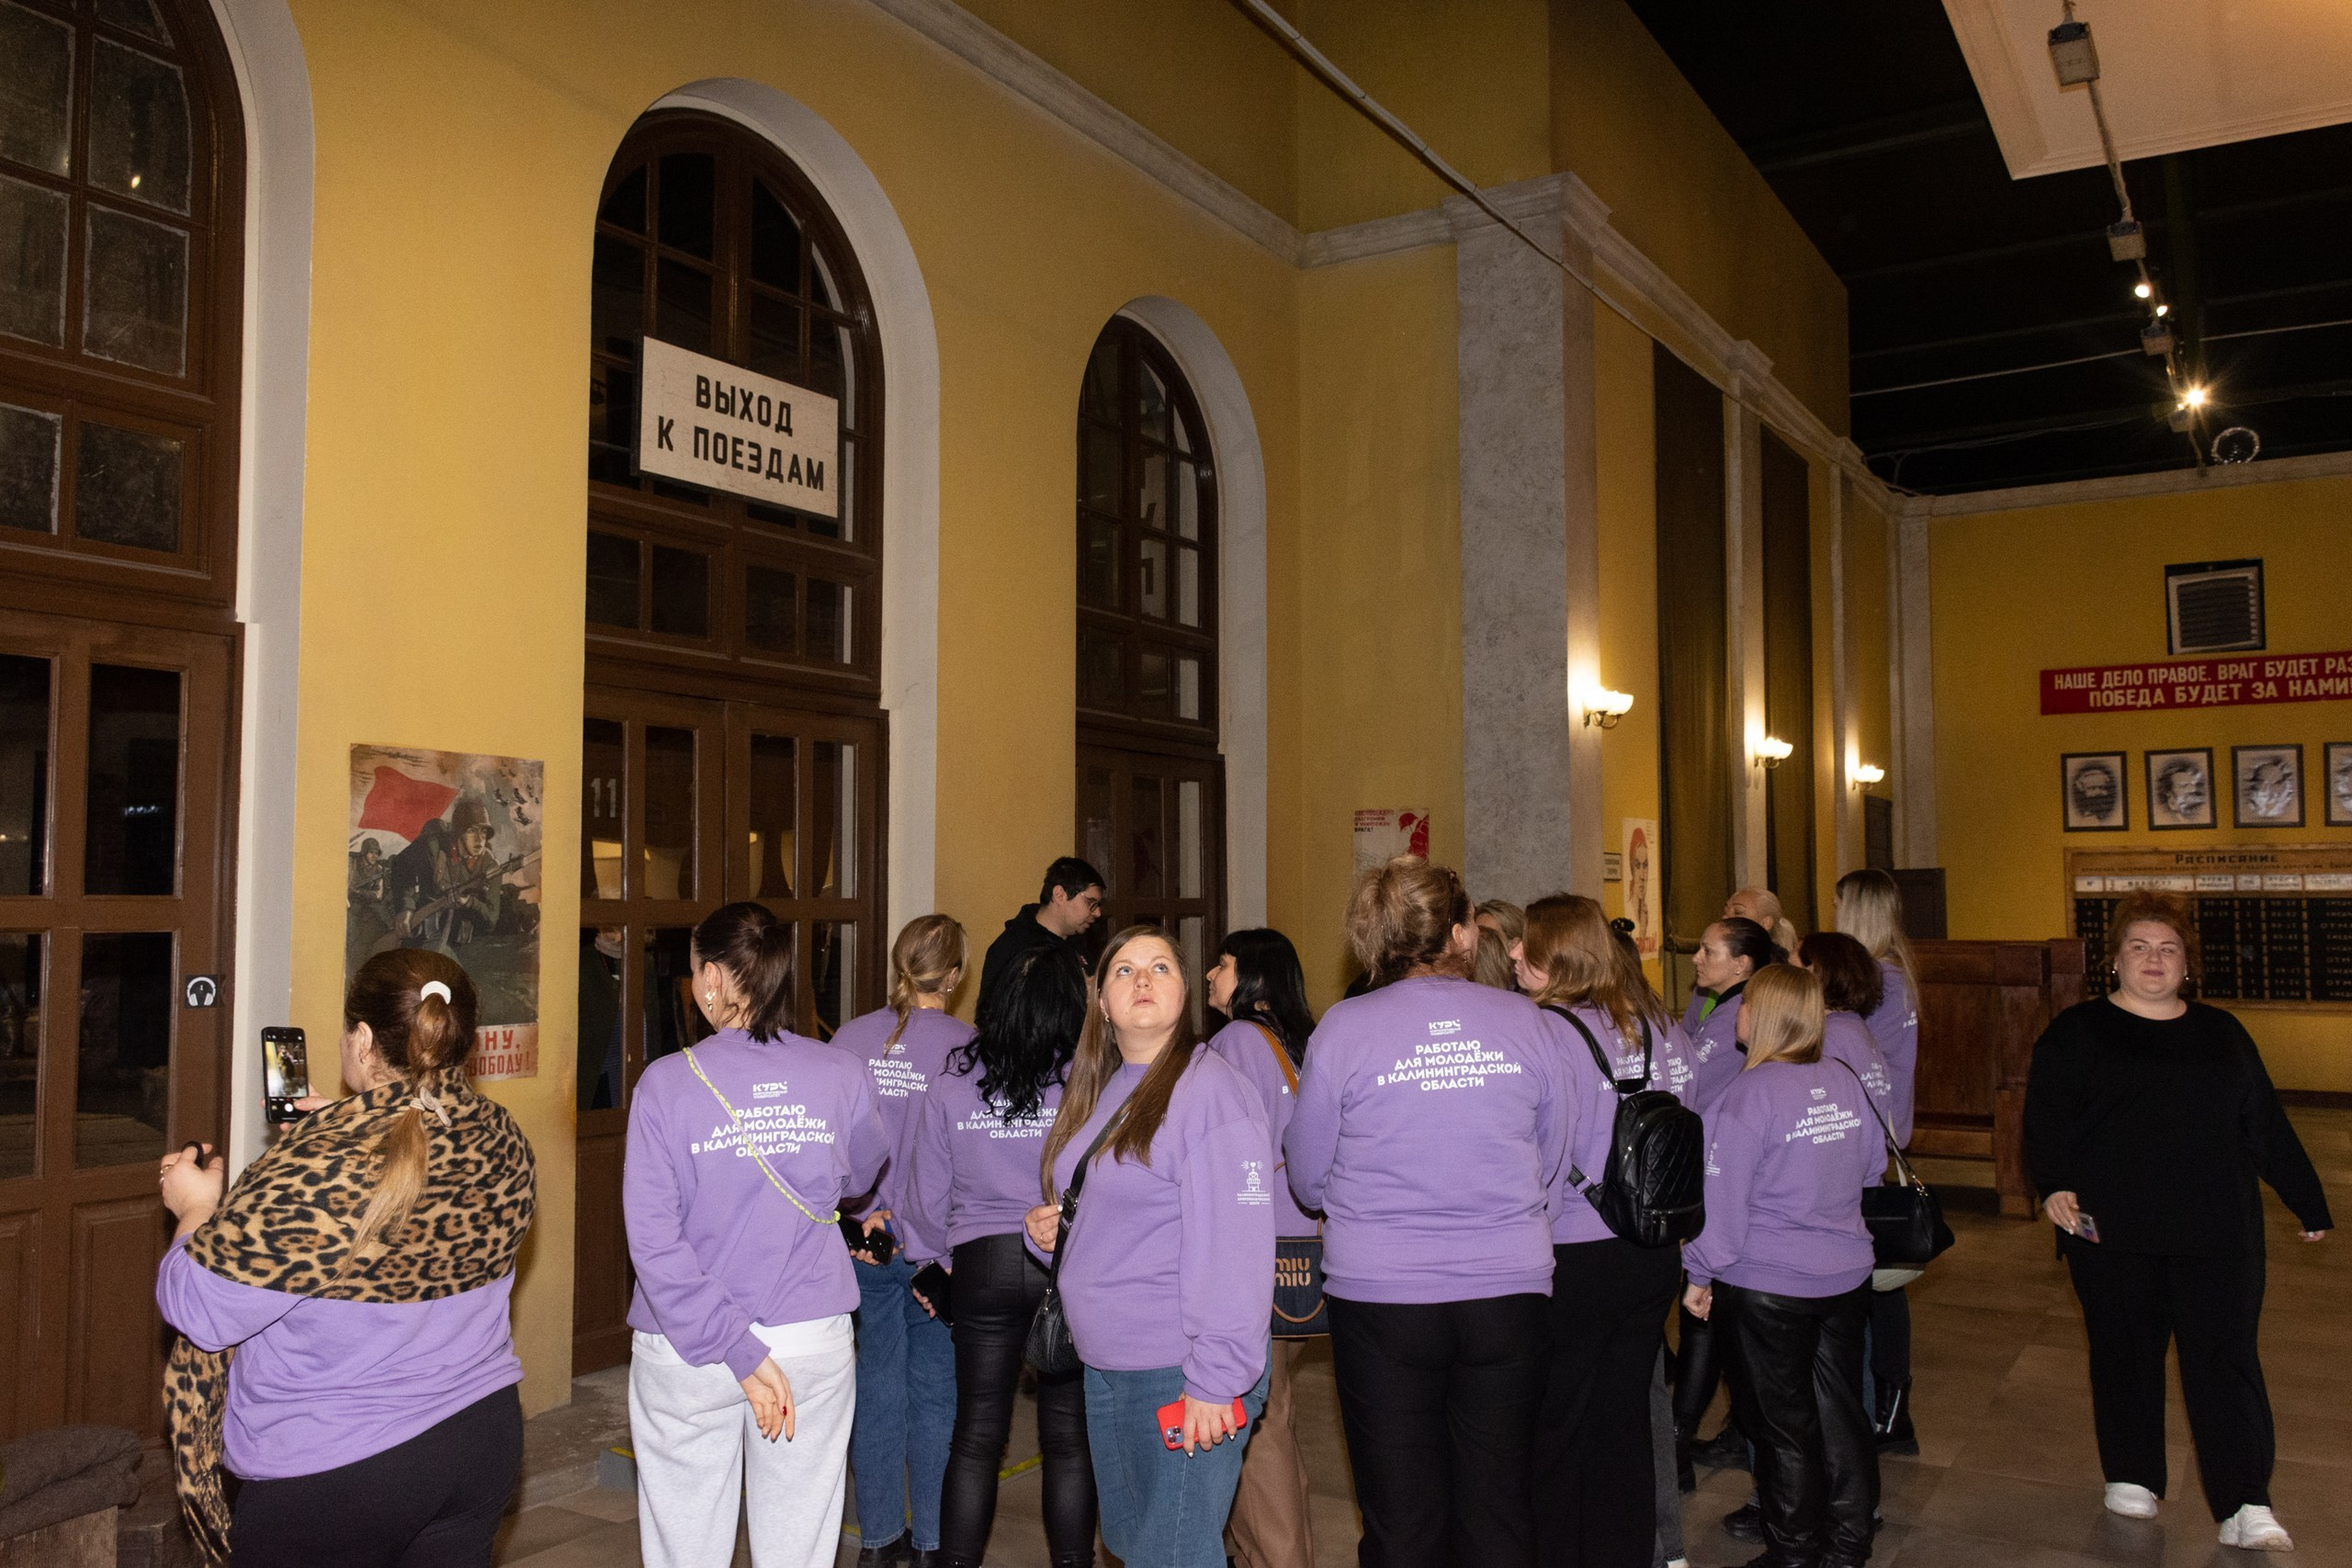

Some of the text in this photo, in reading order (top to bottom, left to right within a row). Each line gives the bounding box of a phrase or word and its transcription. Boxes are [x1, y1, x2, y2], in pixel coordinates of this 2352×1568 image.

[696, 375, 793, 437] ВЫХОД
[658, 415, 824, 491] К ПОЕЗДАМ
[2054, 672, 2097, 690] НАШЕ
[2101, 669, 2143, 689] ДЕЛО
[2148, 665, 2211, 685] ПРАВОЕ.
[2218, 662, 2257, 681] ВРАГ
[2265, 659, 2319, 678] БУДЕТ
[2089, 688, 2165, 707] ПОБЕДА
[2175, 683, 2242, 704] БУДЕТ
[2251, 682, 2278, 699] ЗА
[591, 777, 616, 818] 11
[1416, 1040, 1481, 1055] РАБОТАЮ
[469, 1052, 529, 1077] ВОБОДУ!
[868, 1058, 912, 1069] РАБОТАЮ
[1395, 1049, 1504, 1071] ДЛЯ МОЛОДЁЖИ
[1377, 1062, 1521, 1086] В КАЛИНИНГРАДСКОЙ
[1282, 1086, 1289, 1094] В
[1420, 1077, 1485, 1091] ОБЛАСТИ
[878, 1088, 909, 1098] ЛАСТИ
[736, 1104, 806, 1120] РАБОТАЮ
[712, 1115, 827, 1139] ДЛЯ МОЛОДЁЖИ
[957, 1122, 964, 1130] В
[989, 1129, 1042, 1138] ОБЛАСТИ
[1813, 1131, 1846, 1145] ОБЛАСТИ
[691, 1143, 701, 1154] В
